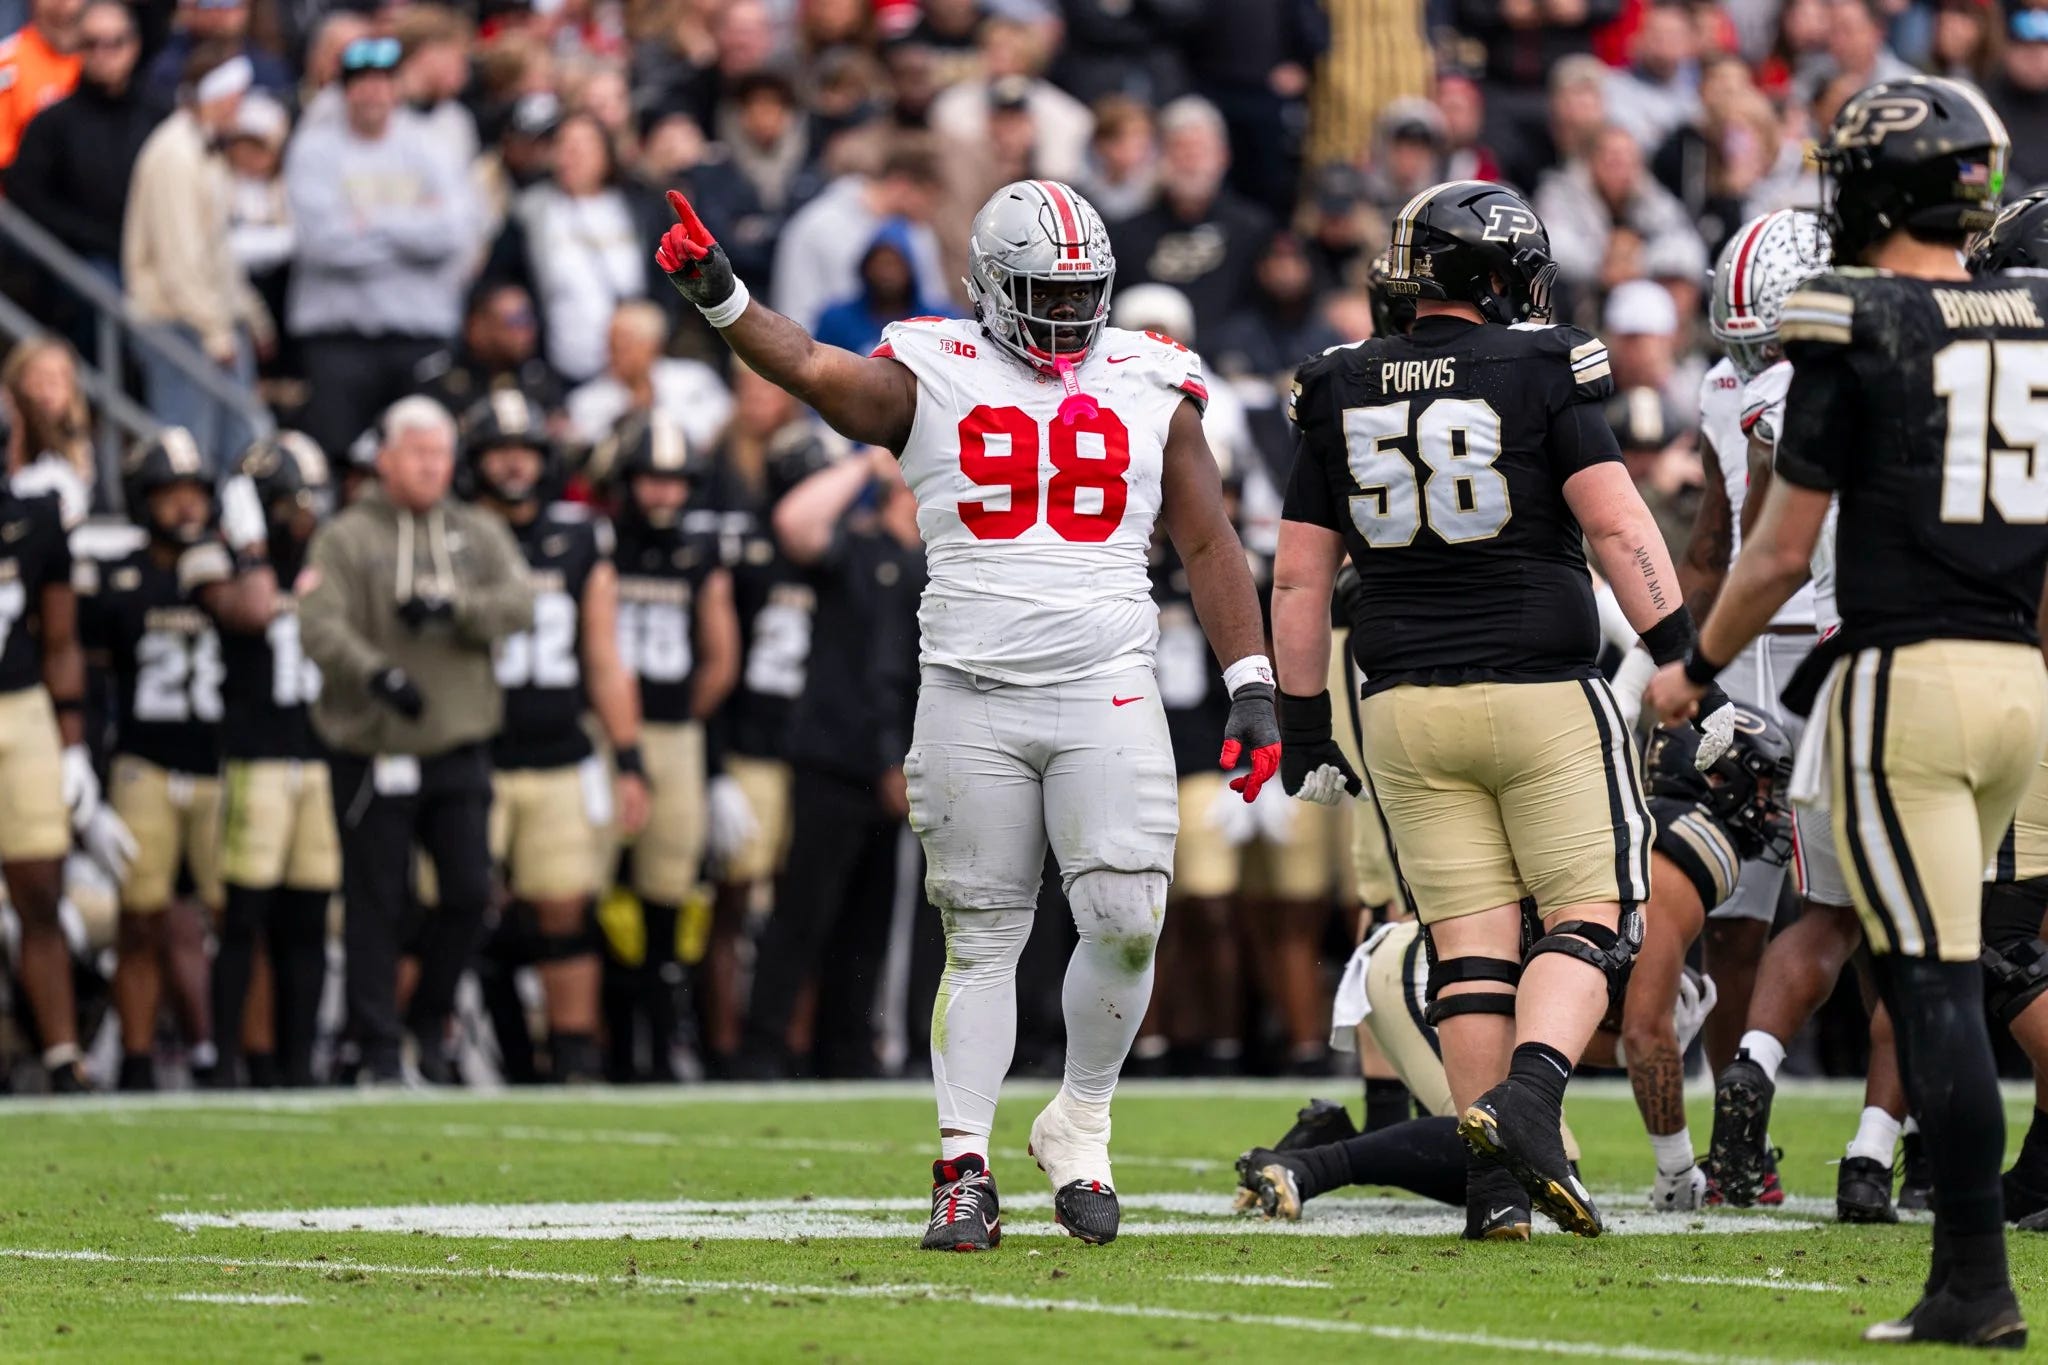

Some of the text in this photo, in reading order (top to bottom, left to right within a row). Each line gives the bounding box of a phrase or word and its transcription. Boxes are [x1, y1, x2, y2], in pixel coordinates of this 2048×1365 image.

[1836, 98, 1929, 146] P
[1481, 205, 1537, 244] P
[1057, 262, 1092, 271] OHIO STATE
[1931, 288, 2046, 329] BROWNE
[1381, 356, 1457, 395] PURVIS
[1932, 338, 2048, 525] 15
[957, 404, 1131, 543] 98
[1342, 398, 1513, 548] 58
[1633, 545, 1669, 610] MMII MMV
